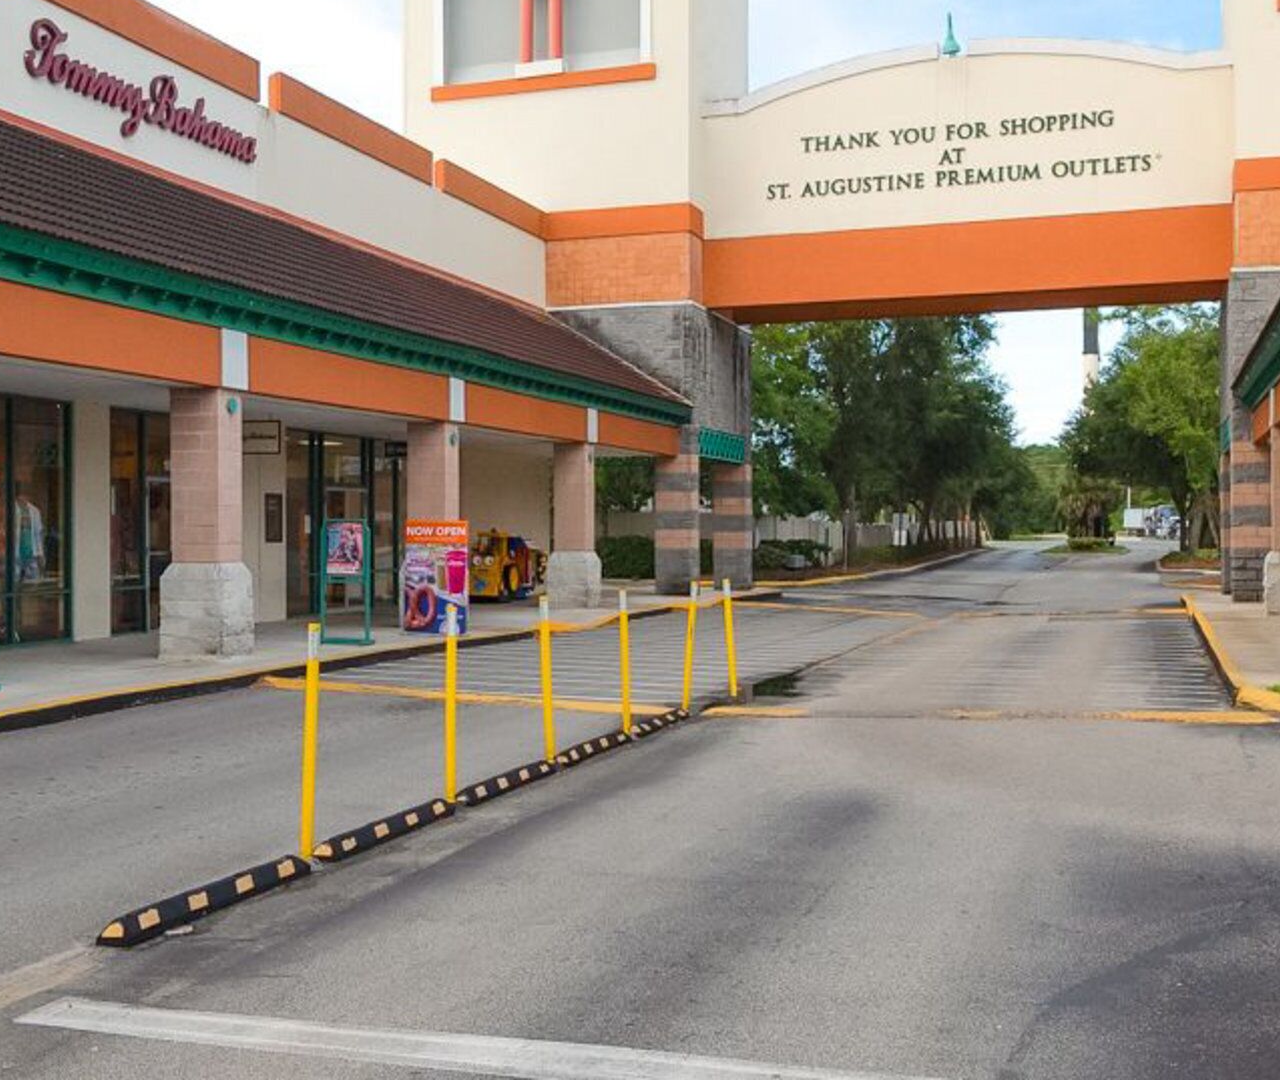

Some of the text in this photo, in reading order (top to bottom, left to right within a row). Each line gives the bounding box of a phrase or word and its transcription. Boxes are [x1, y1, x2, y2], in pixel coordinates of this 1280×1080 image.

[24, 18, 257, 163] Tommy Bahama
[801, 109, 1115, 153] THANK YOU FOR SHOPPING
[767, 154, 1152, 201] ST. AUGUSTINE PREMIUM OUTLETS
[938, 148, 966, 166] AT
[406, 526, 466, 536] NOW OPEN
